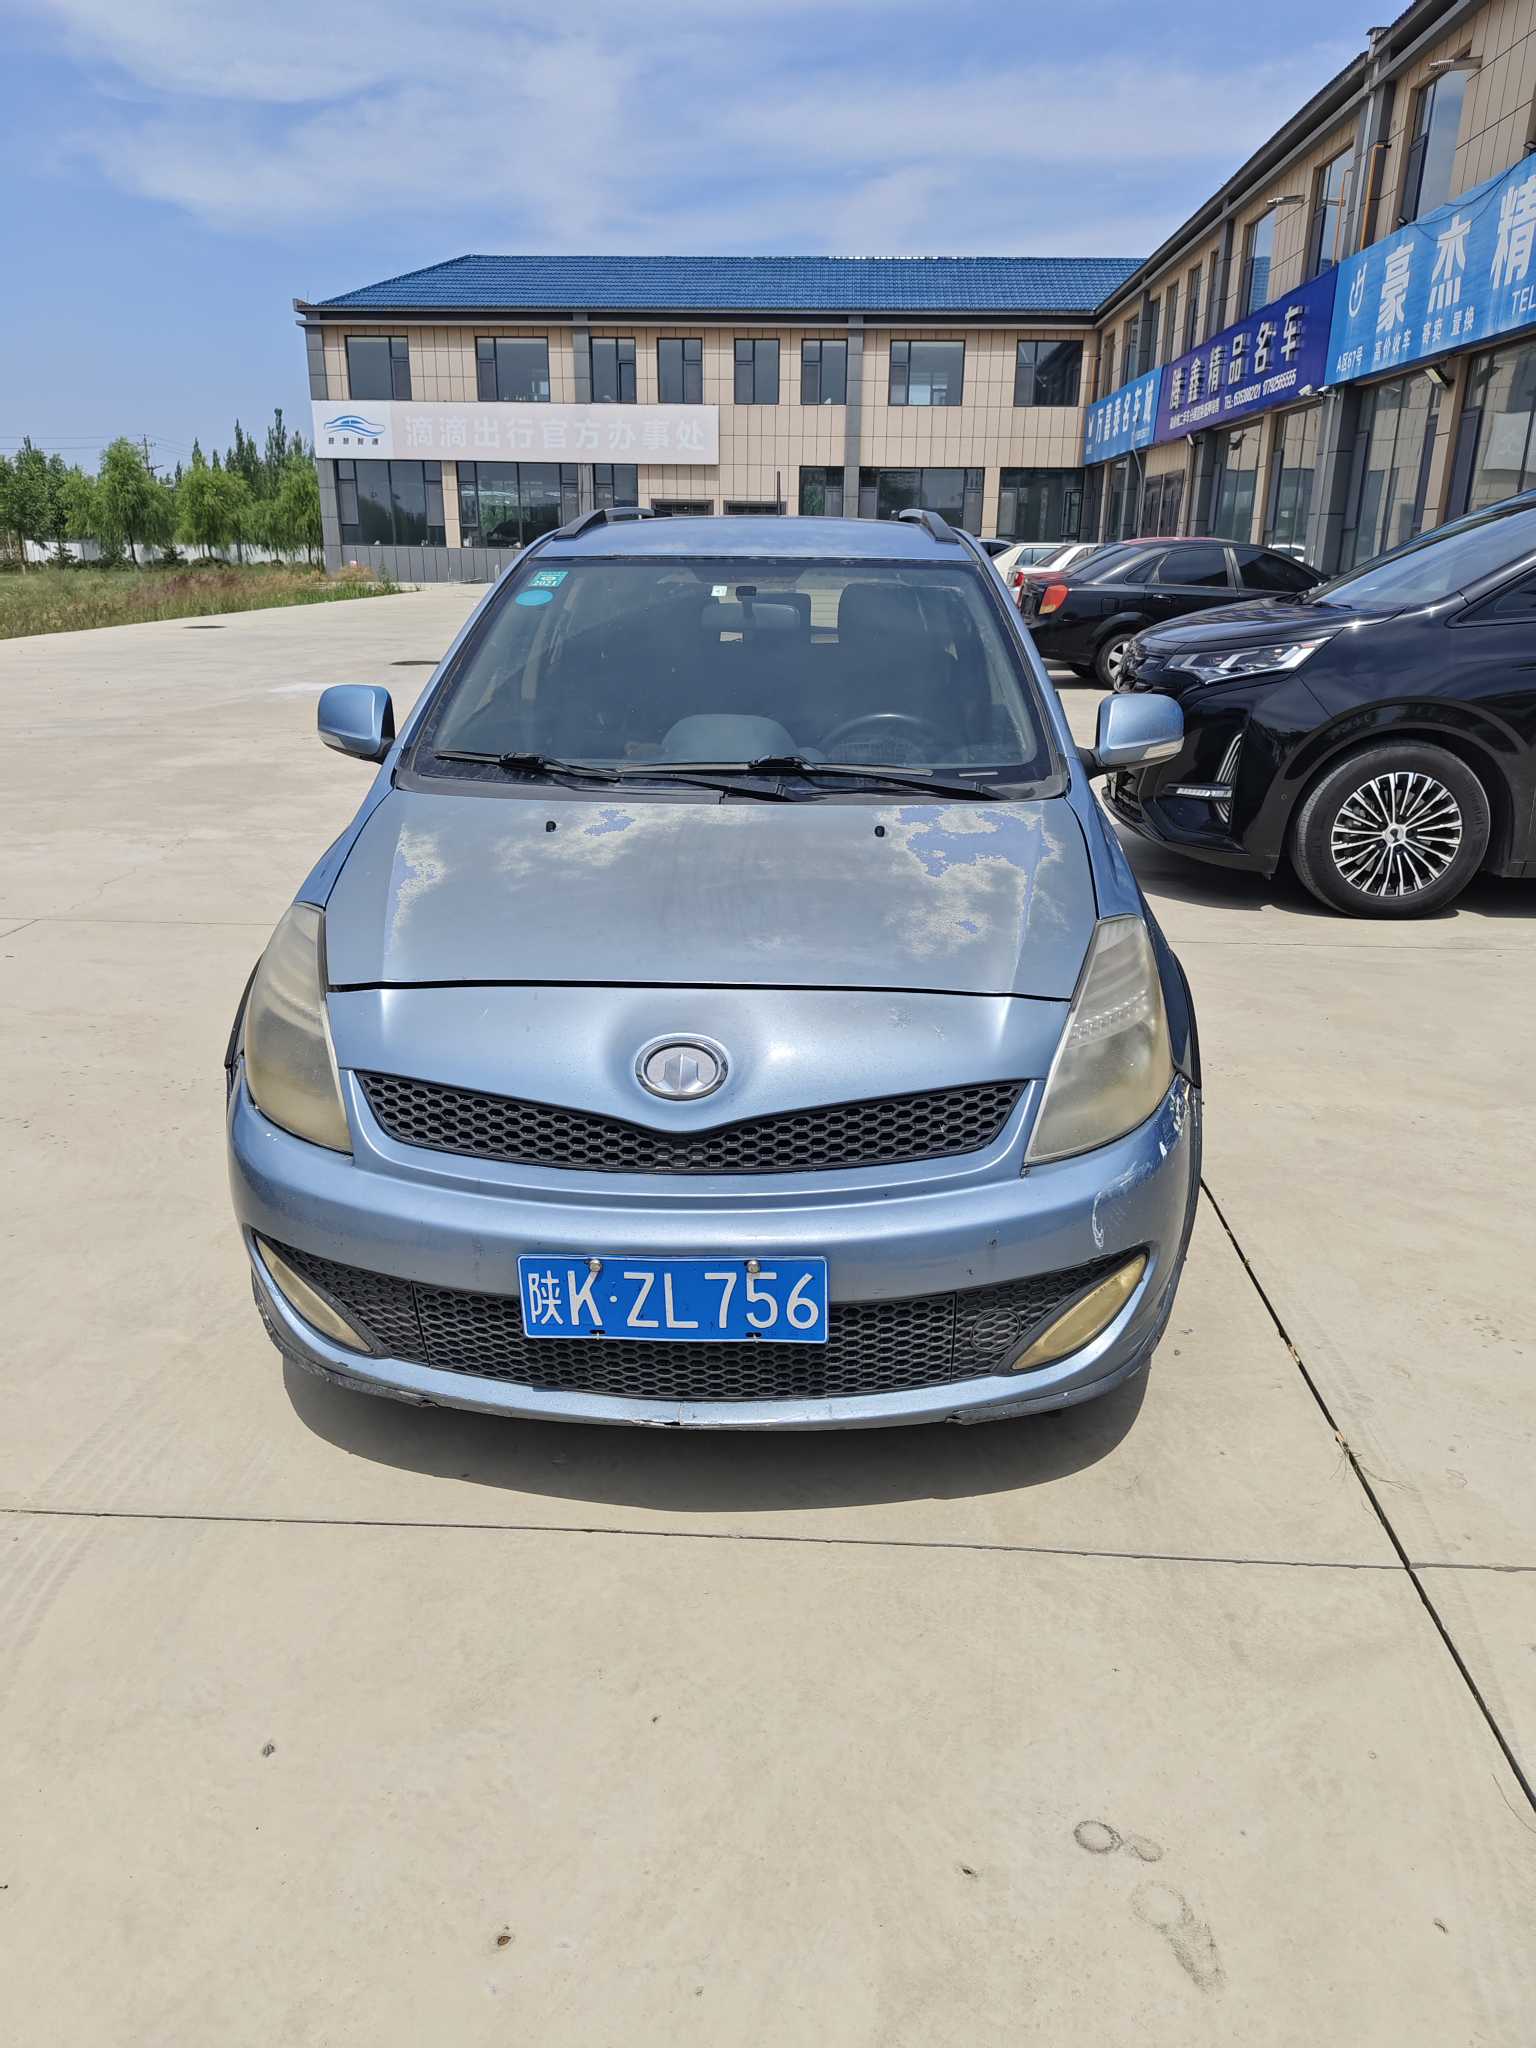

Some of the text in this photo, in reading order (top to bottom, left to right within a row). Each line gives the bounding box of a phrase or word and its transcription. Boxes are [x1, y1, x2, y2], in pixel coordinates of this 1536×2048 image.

[1374, 328, 1413, 361] 高价收车
[1451, 305, 1475, 337] 置换
[404, 414, 706, 451] 滴滴出行官方办事处
